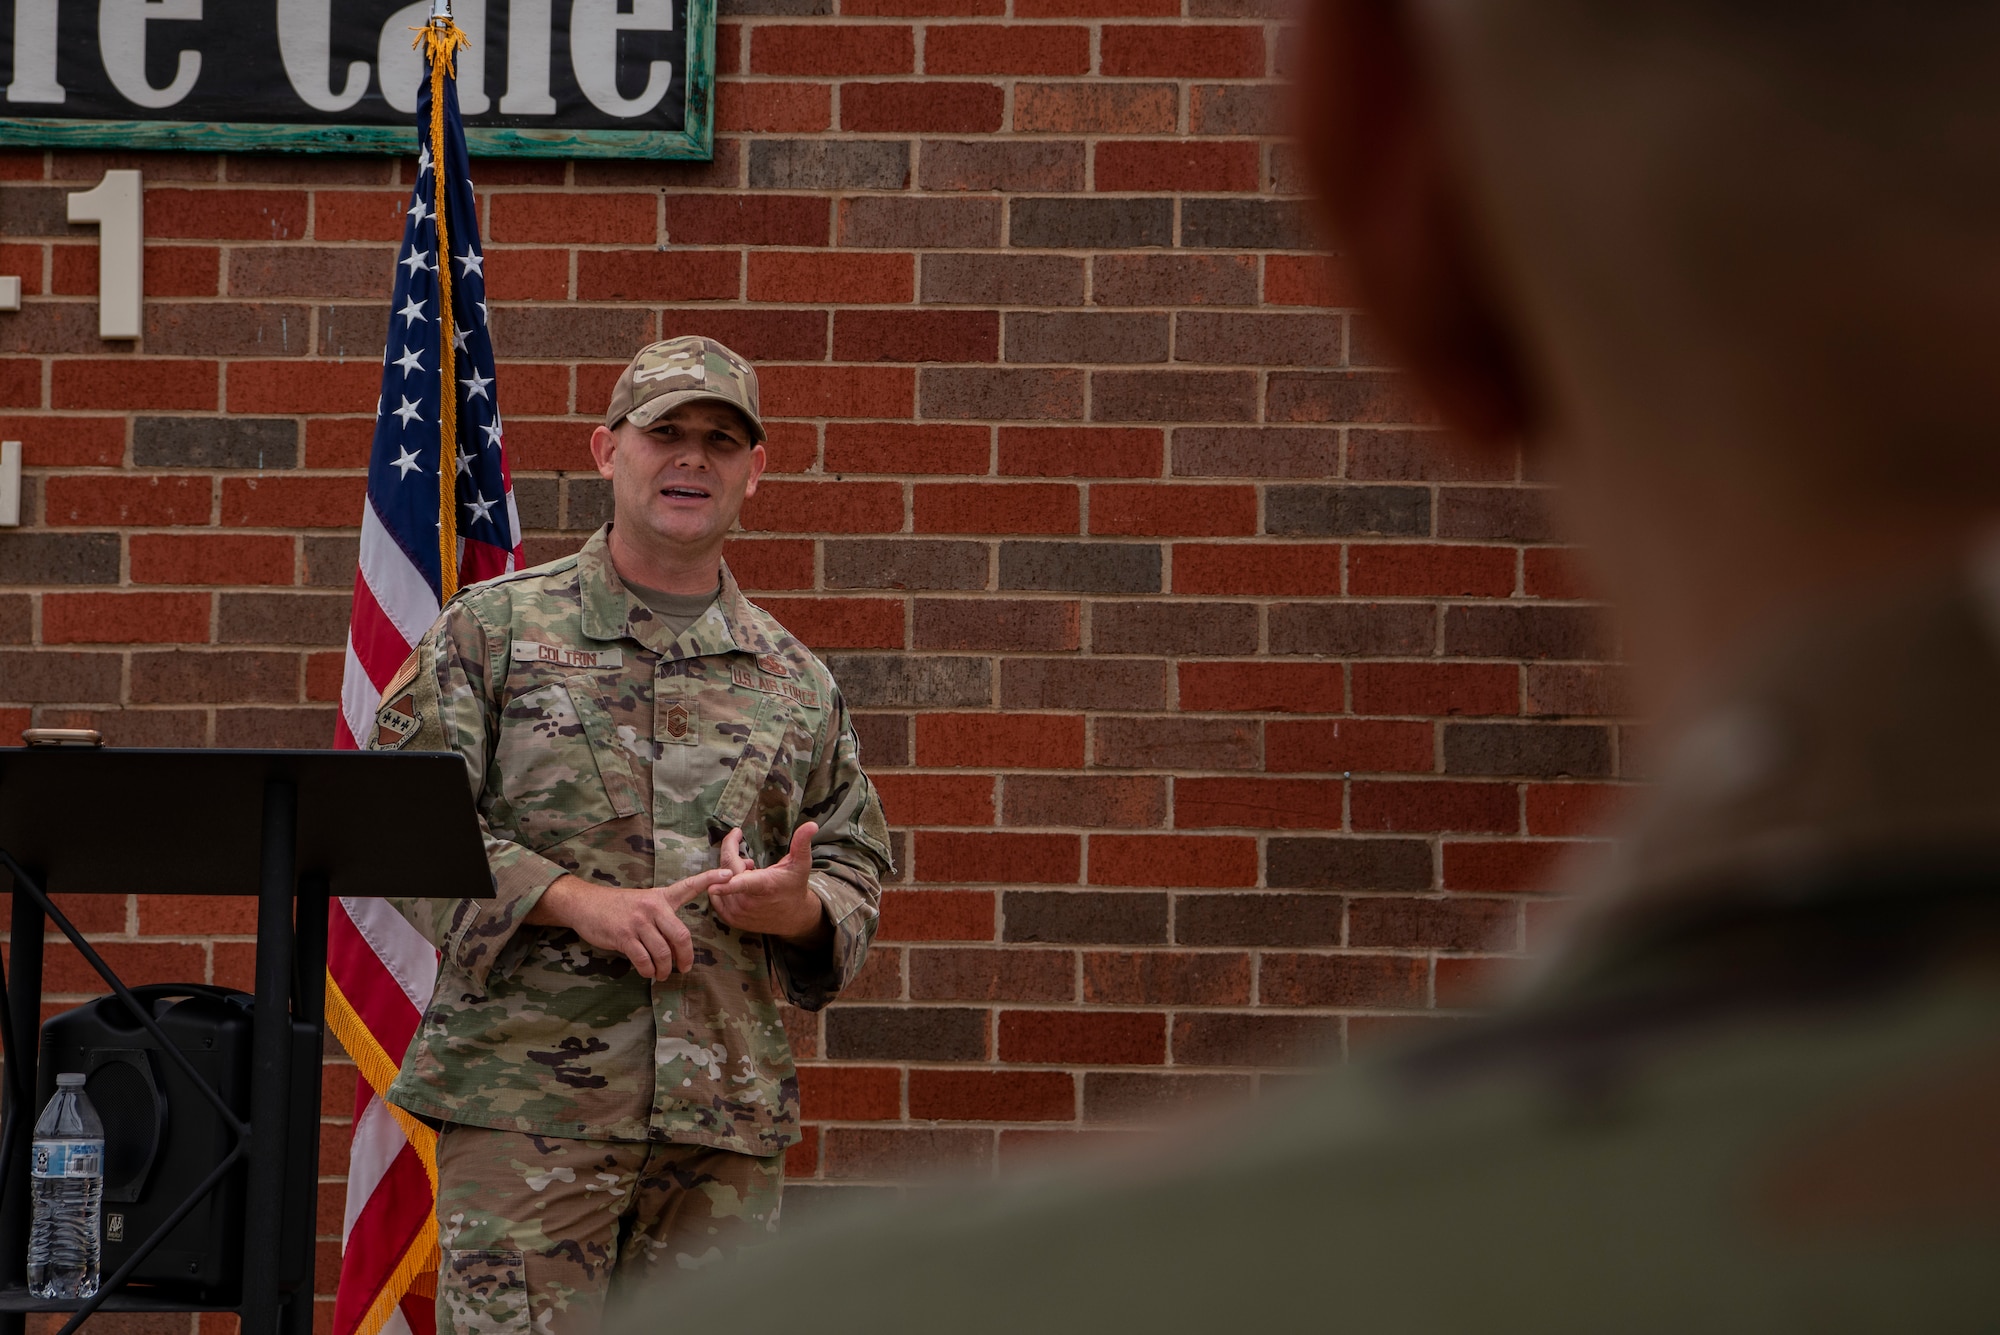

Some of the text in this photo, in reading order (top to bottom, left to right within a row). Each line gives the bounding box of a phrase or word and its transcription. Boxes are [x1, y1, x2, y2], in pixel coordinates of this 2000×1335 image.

[538, 645, 598, 668] COLTRIN
[732, 668, 820, 707] U.S. AIR FORCE
